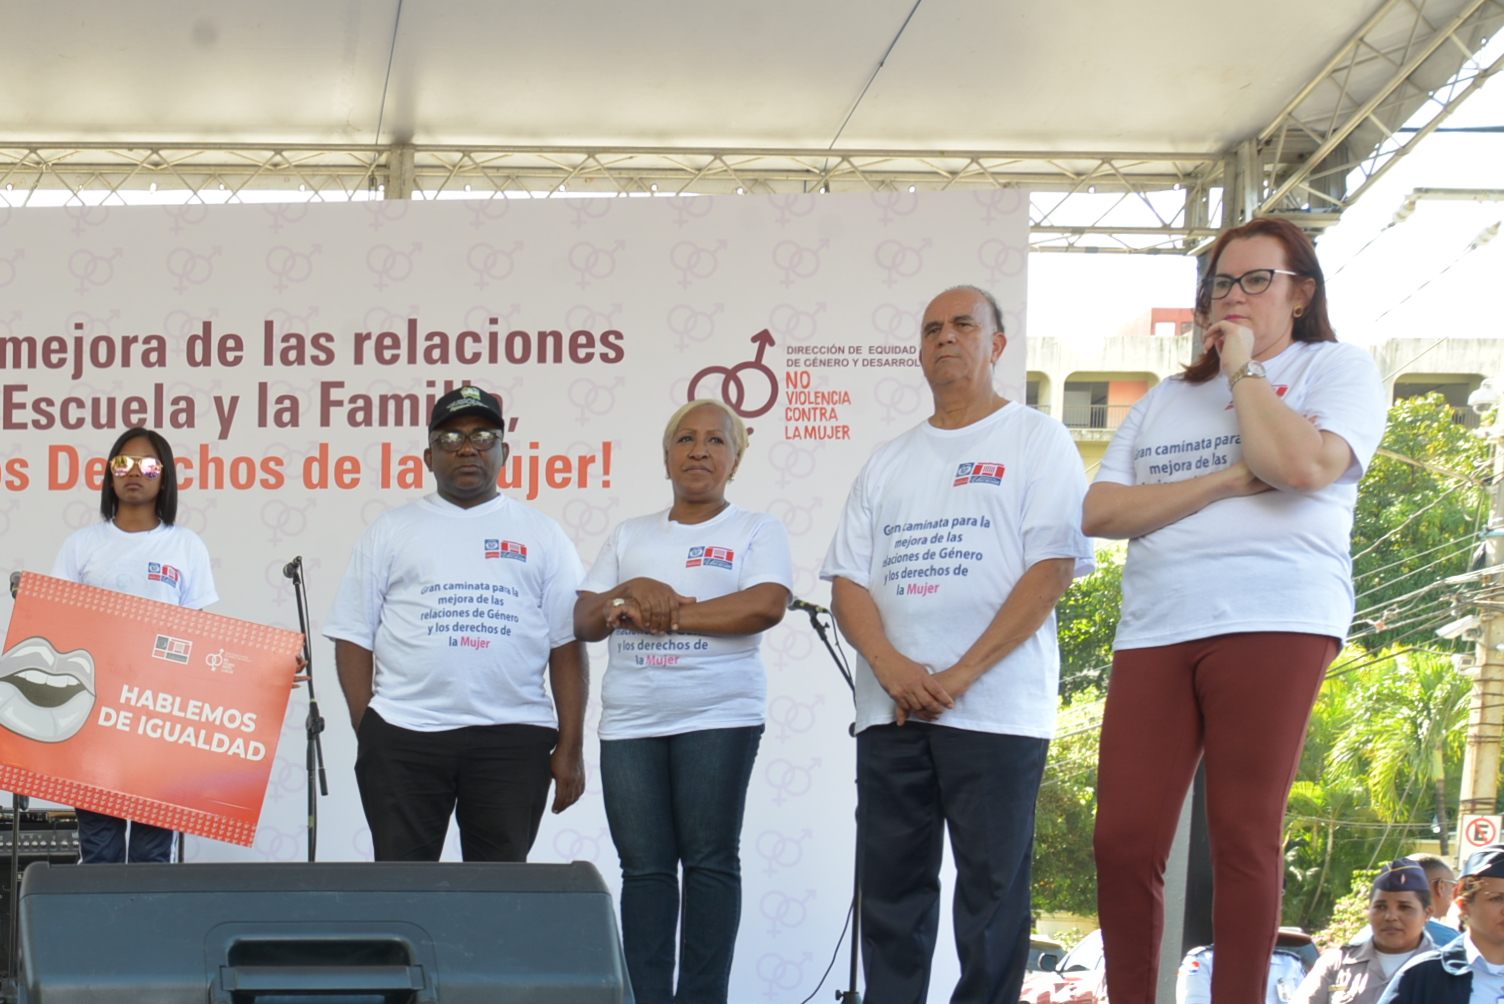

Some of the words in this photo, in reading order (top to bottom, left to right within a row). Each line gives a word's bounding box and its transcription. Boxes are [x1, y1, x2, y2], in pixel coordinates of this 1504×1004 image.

[186, 321, 243, 367] de
[264, 320, 334, 366] las
[353, 317, 625, 365] relaciones
[786, 343, 845, 355] DIRECCIÓN
[848, 346, 863, 355] DE
[868, 346, 917, 355] EQUIDAD
[786, 359, 801, 368] DE
[804, 356, 849, 368] GÉNERO
[852, 359, 860, 367] Y
[862, 358, 920, 367] DESARROL
[786, 371, 811, 389] NO
[786, 390, 851, 406] VIOLENCIA
[2, 383, 195, 431] Escuela
[213, 396, 240, 440] y
[258, 382, 299, 428] la
[785, 407, 838, 422] CONTRA
[1155, 438, 1212, 456] caminata
[48, 443, 285, 490] Dechos
[303, 443, 360, 489] de
[381, 442, 422, 489] la
[496, 441, 612, 500] ujer!
[1149, 460, 1192, 477] mejora
[1195, 455, 1210, 470] de
[1212, 453, 1228, 466] las
[951, 517, 977, 529] para
[980, 515, 991, 529] la
[894, 536, 927, 550] mejora
[930, 532, 944, 545] de
[946, 531, 963, 543] las
[922, 547, 936, 561] de
[938, 547, 983, 562] Género
[888, 570, 899, 582] los
[901, 565, 950, 580] derechos
[953, 564, 969, 577] de
[443, 581, 491, 592] caminata
[512, 586, 519, 598] la
[896, 584, 904, 596] la
[906, 583, 939, 597] Mujer
[437, 594, 474, 606] mejora
[476, 593, 490, 605] de
[491, 595, 504, 607] las
[420, 608, 470, 621] relaciones
[472, 607, 486, 619] de
[486, 608, 519, 624] Género
[427, 624, 433, 636] y
[435, 622, 450, 633] los
[452, 621, 498, 636] derechos
[500, 625, 511, 637] de
[448, 636, 459, 647] la
[460, 636, 490, 650] Mujer
[623, 640, 635, 650] los
[637, 639, 690, 650] derechos
[694, 639, 708, 650] de
[635, 655, 644, 665] la
[646, 655, 680, 667] Mujer
[119, 684, 257, 733] HABLEMOS
[98, 707, 133, 732] DE
[138, 717, 266, 762] IGUALDAD
